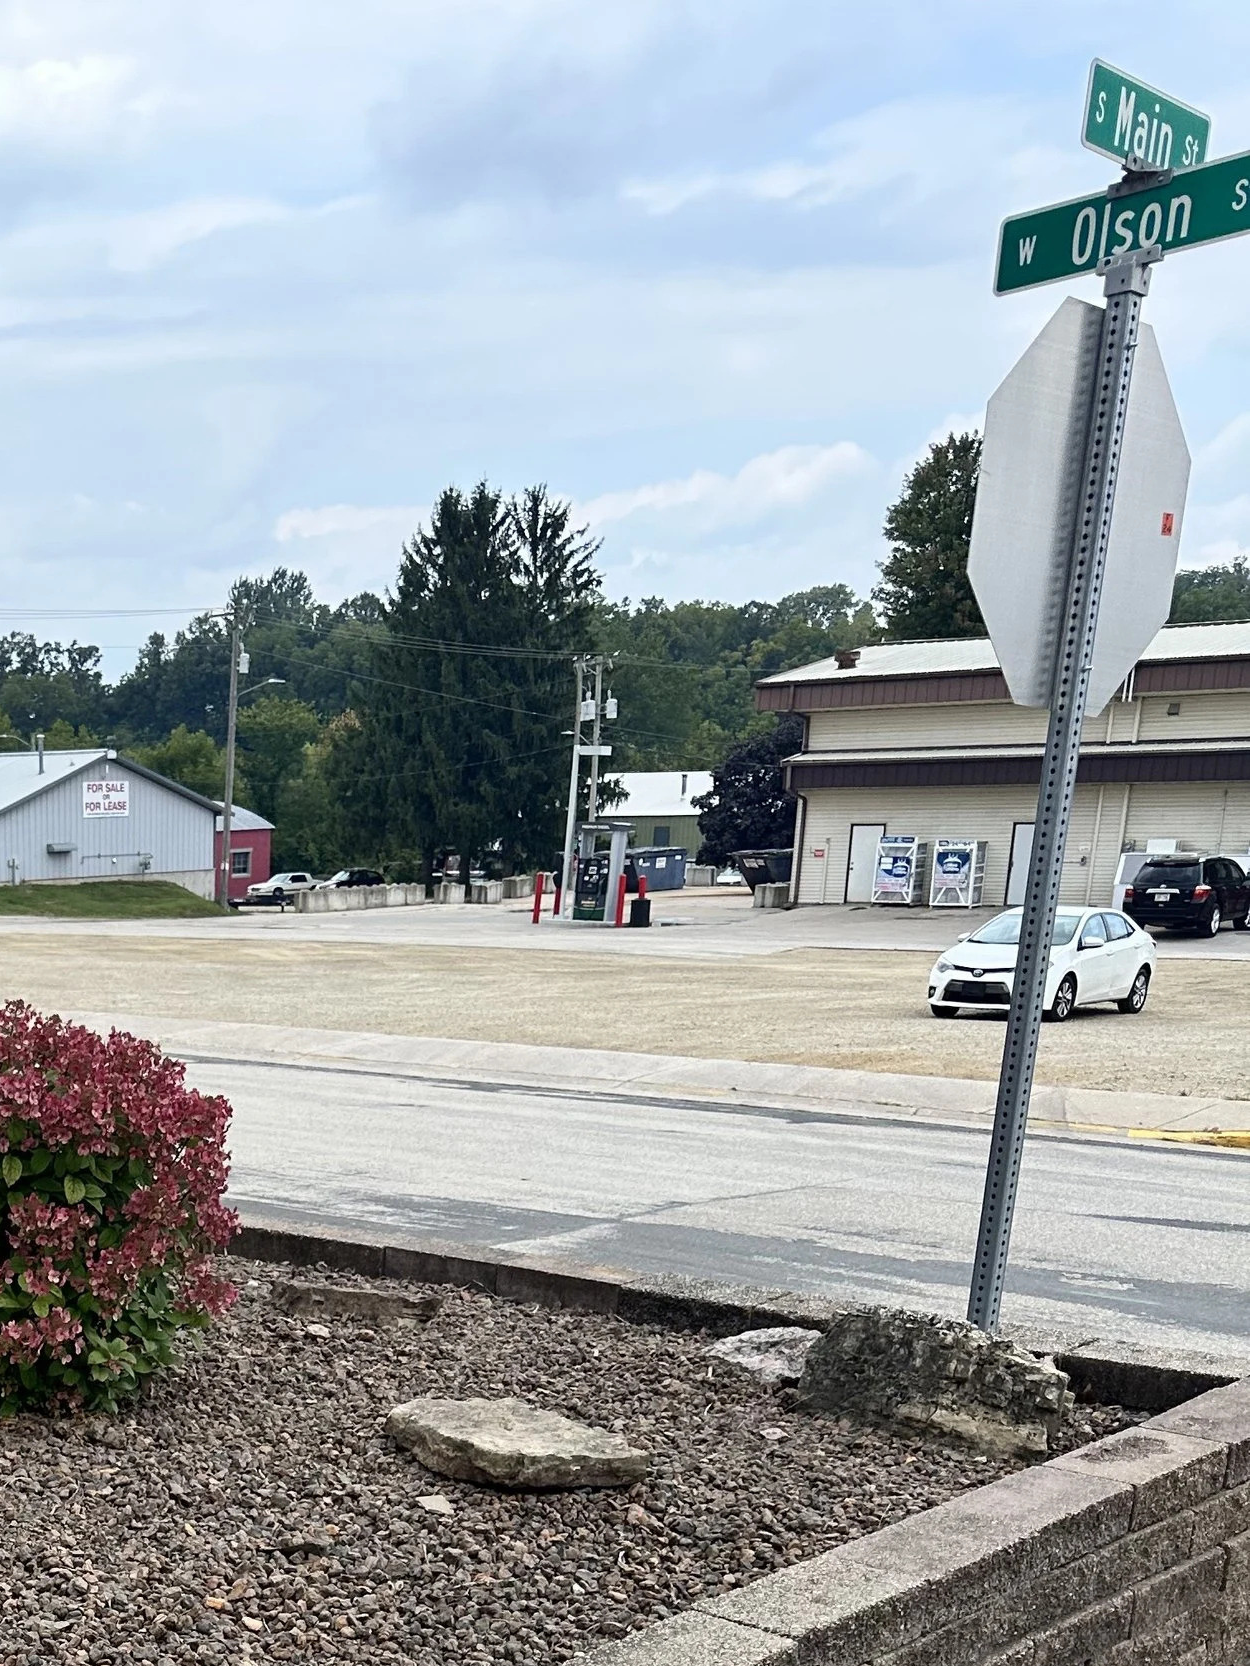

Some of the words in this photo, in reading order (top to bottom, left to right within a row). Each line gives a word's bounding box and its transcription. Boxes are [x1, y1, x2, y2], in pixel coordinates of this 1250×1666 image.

[1096, 91, 1106, 122] S
[1113, 86, 1173, 170] Main
[1182, 135, 1199, 166] St
[1019, 235, 1037, 267] W
[1071, 194, 1192, 266] Olson
[1231, 178, 1250, 211] S
[85, 802, 101, 811] FOR
[103, 801, 127, 811] LEASE
[87, 783, 103, 793] FOR
[105, 783, 124, 792] SALE
